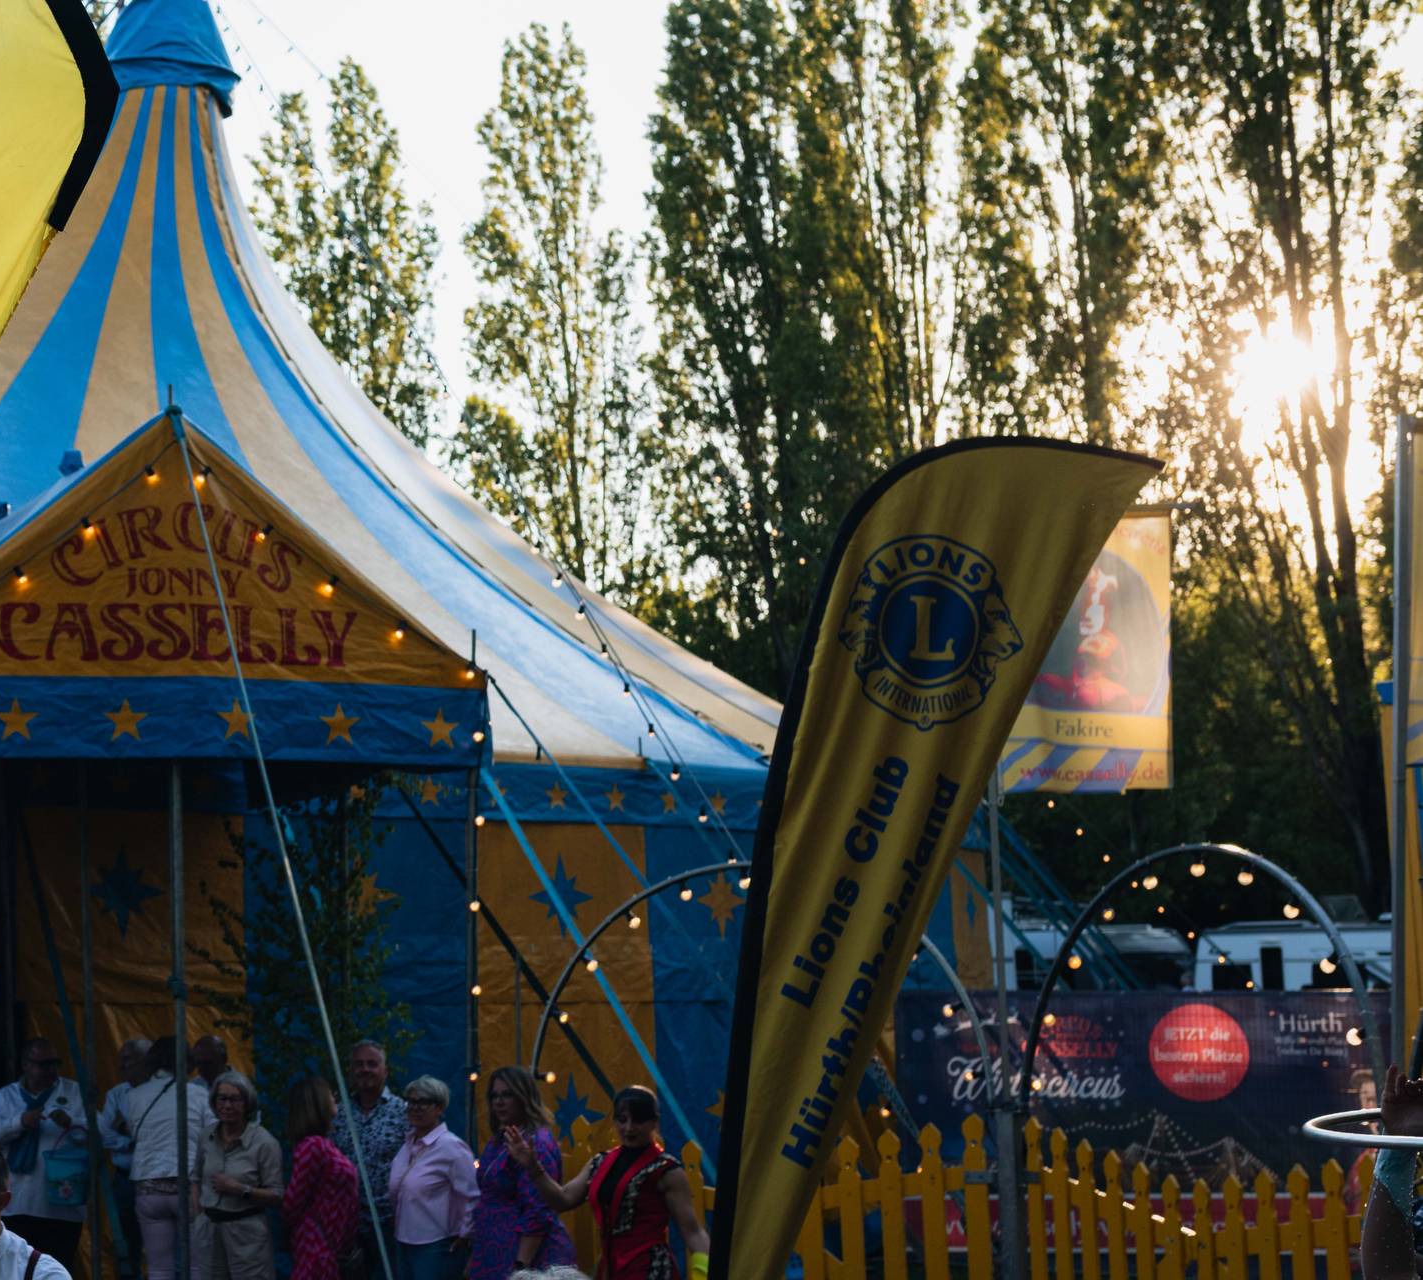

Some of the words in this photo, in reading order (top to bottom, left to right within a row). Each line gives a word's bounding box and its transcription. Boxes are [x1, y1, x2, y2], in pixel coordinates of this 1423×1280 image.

[49, 501, 305, 593] CIRCUS
[874, 542, 988, 586] LIONS
[126, 566, 244, 599] JONNY
[908, 594, 956, 662] L
[1056, 718, 1113, 738] Fakire
[1019, 760, 1164, 787] www.casselly.de
[781, 875, 860, 1009] Lions
[844, 755, 909, 864] Club
[1162, 1027, 1207, 1045] JETZT
[1209, 1027, 1231, 1041] die
[1279, 1011, 1344, 1033] Hürth
[1201, 1047, 1243, 1063] Plätze
